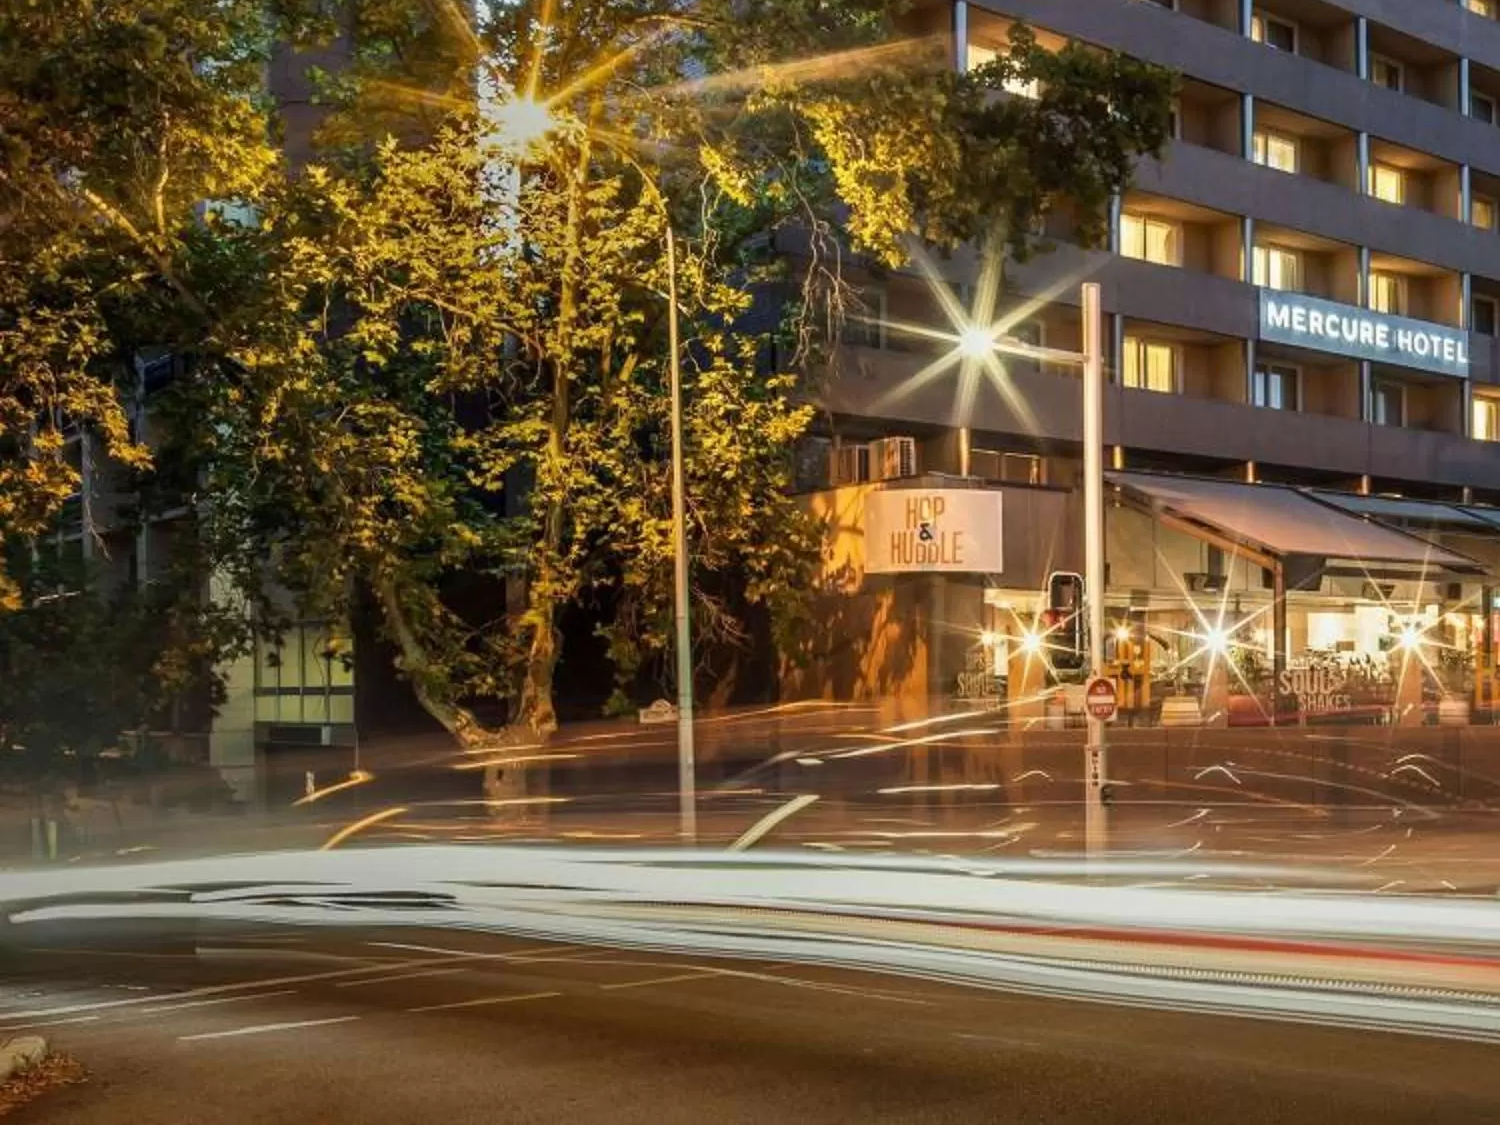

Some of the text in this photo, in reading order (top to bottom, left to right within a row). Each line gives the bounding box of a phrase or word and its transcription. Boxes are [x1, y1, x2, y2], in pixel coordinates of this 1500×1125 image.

[1267, 301, 1468, 363] MERCURE HOTEL
[905, 496, 945, 529] HOP
[919, 522, 934, 542] &
[891, 530, 965, 565] HUDDLE
[1279, 670, 1332, 695] SOUL
[1298, 693, 1352, 712] SHAKES
